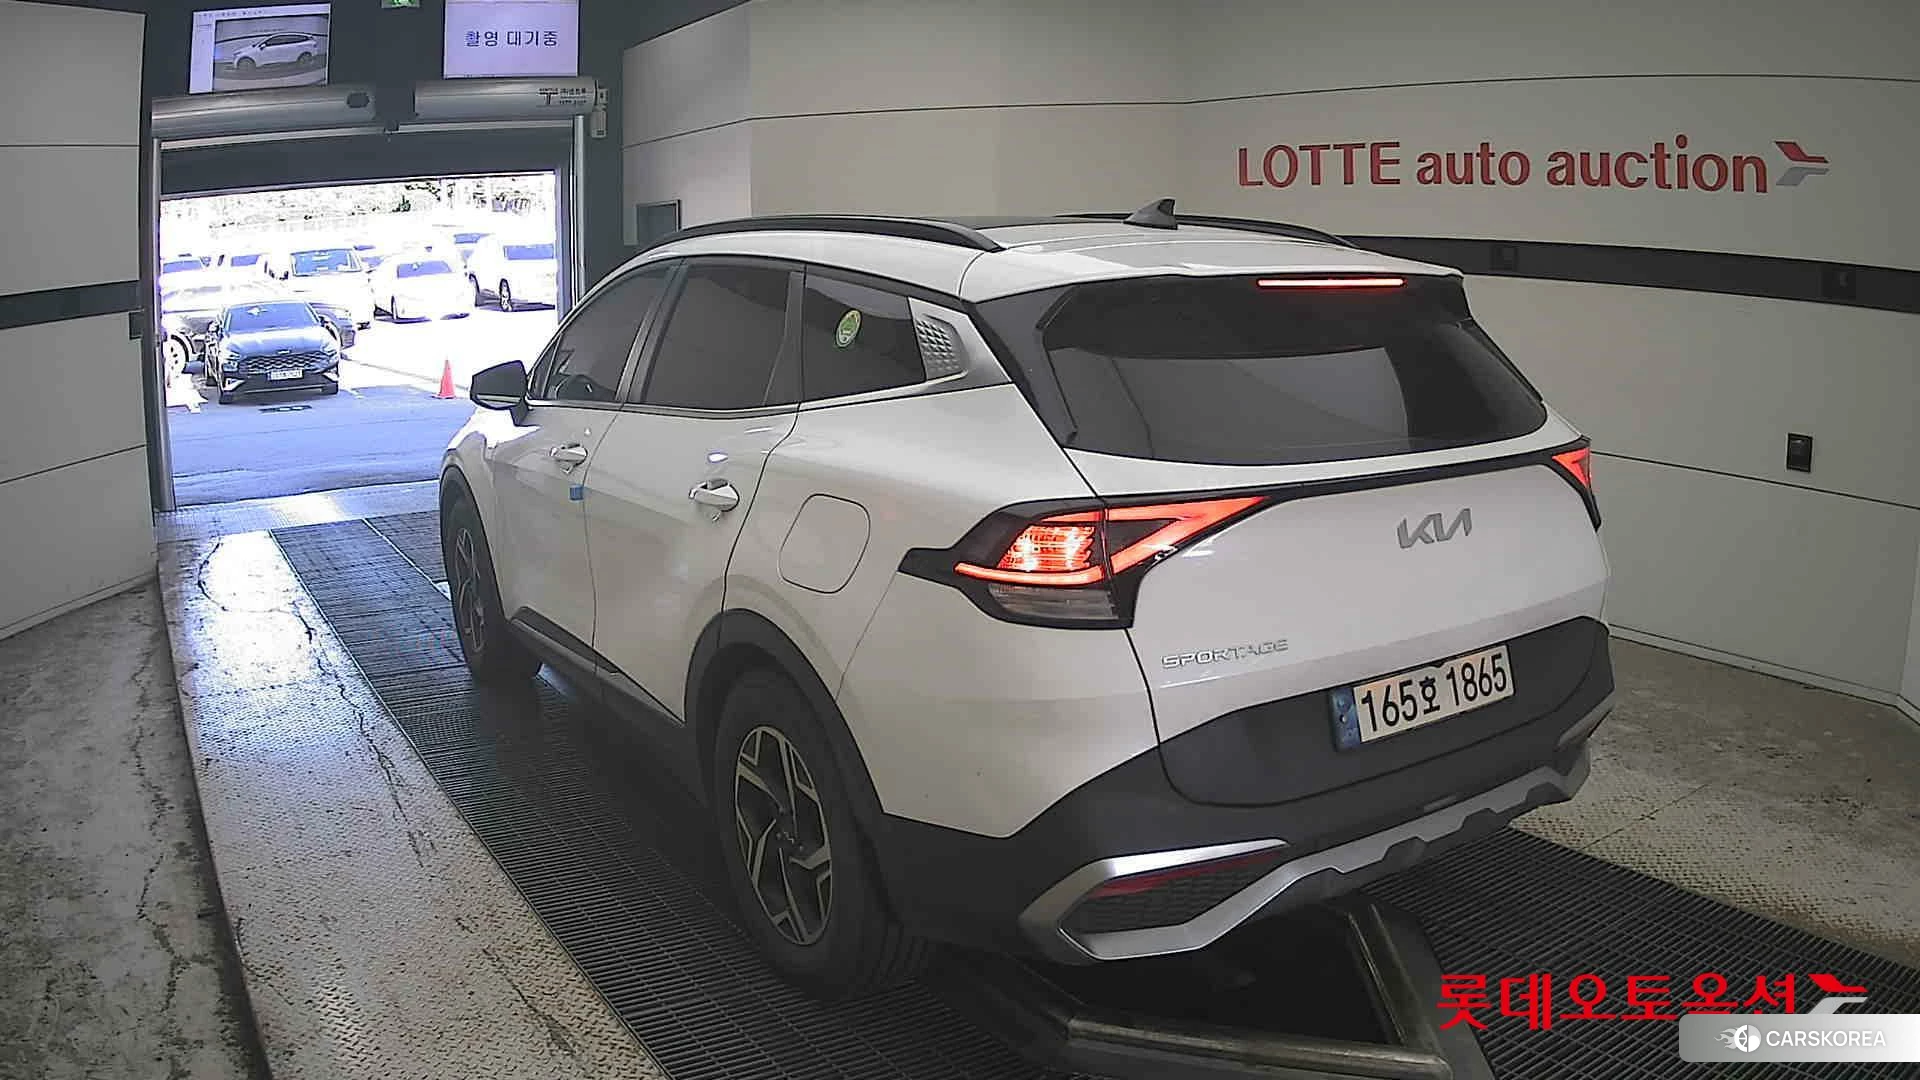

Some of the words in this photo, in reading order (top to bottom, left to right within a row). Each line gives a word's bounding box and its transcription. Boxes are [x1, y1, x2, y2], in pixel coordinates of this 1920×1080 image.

[507, 30, 558, 47] 대기중
[1239, 141, 1400, 187] LOTTE
[1417, 142, 1530, 186] auto
[1546, 134, 1768, 194] auction
[1160, 639, 1289, 669] SPORTAGE
[1361, 676, 1441, 732] 165호
[1446, 653, 1507, 706] 1865
